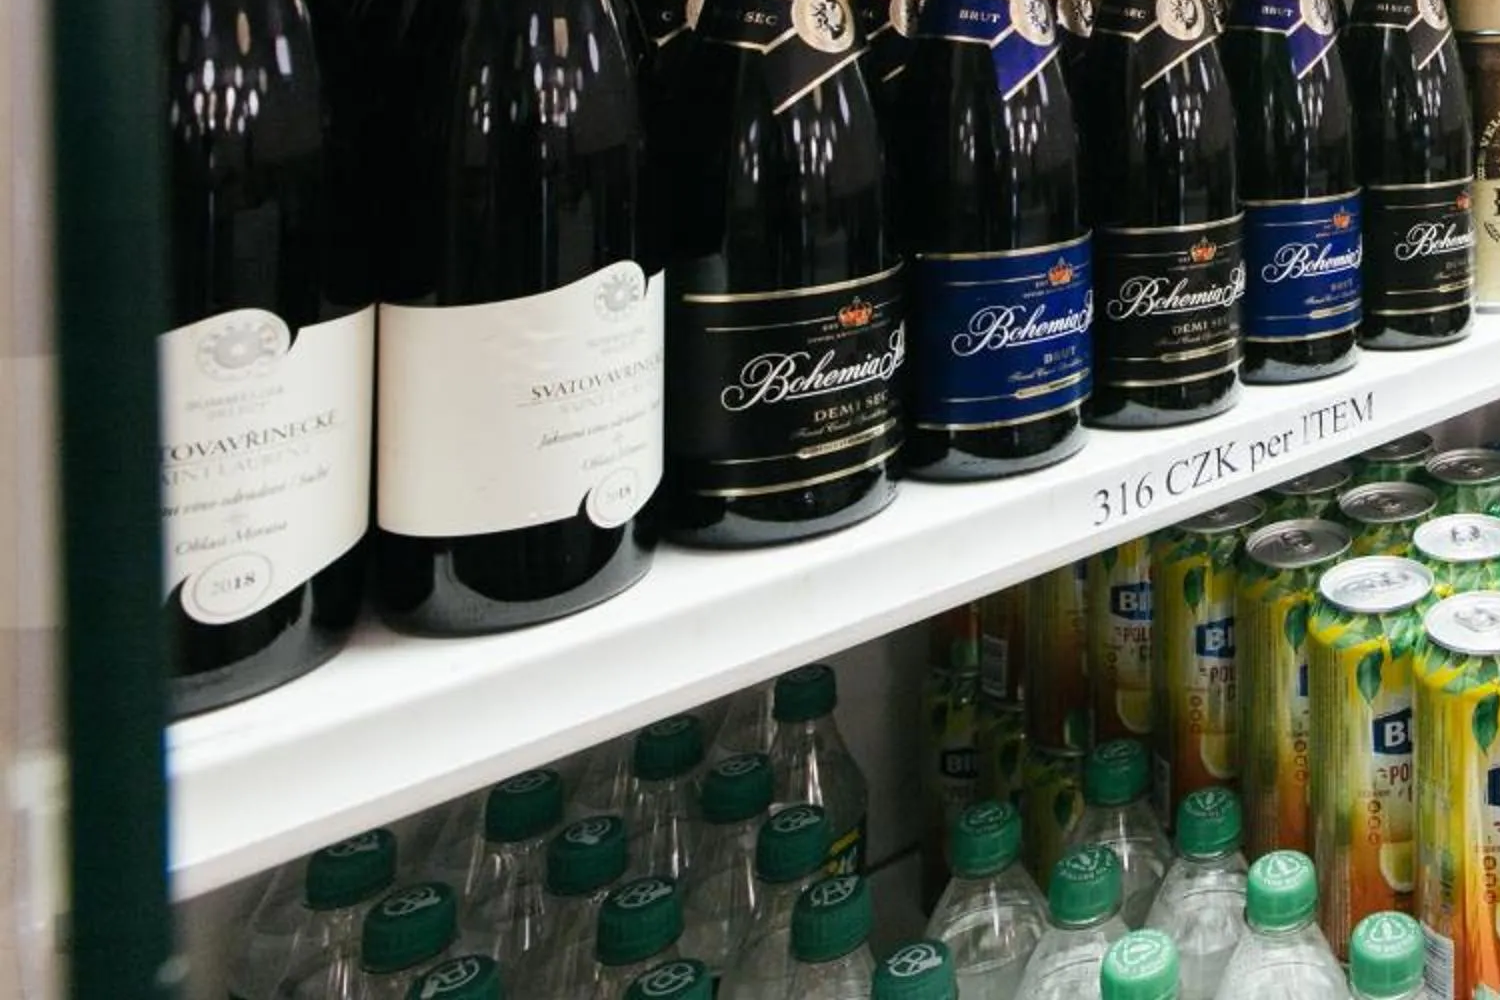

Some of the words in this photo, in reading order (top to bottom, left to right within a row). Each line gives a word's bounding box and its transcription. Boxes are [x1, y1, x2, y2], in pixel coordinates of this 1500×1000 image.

[743, 10, 778, 26] SEC
[959, 9, 1001, 25] BRUT
[1106, 275, 1224, 320] Bohemia
[951, 303, 1081, 357] Bohemia
[720, 350, 881, 412] Bohemia
[814, 400, 861, 422] DEMI
[1092, 480, 1154, 528] 316
[1166, 440, 1240, 495] CZK
[1248, 429, 1294, 473] per
[1301, 391, 1375, 446] ITEM
